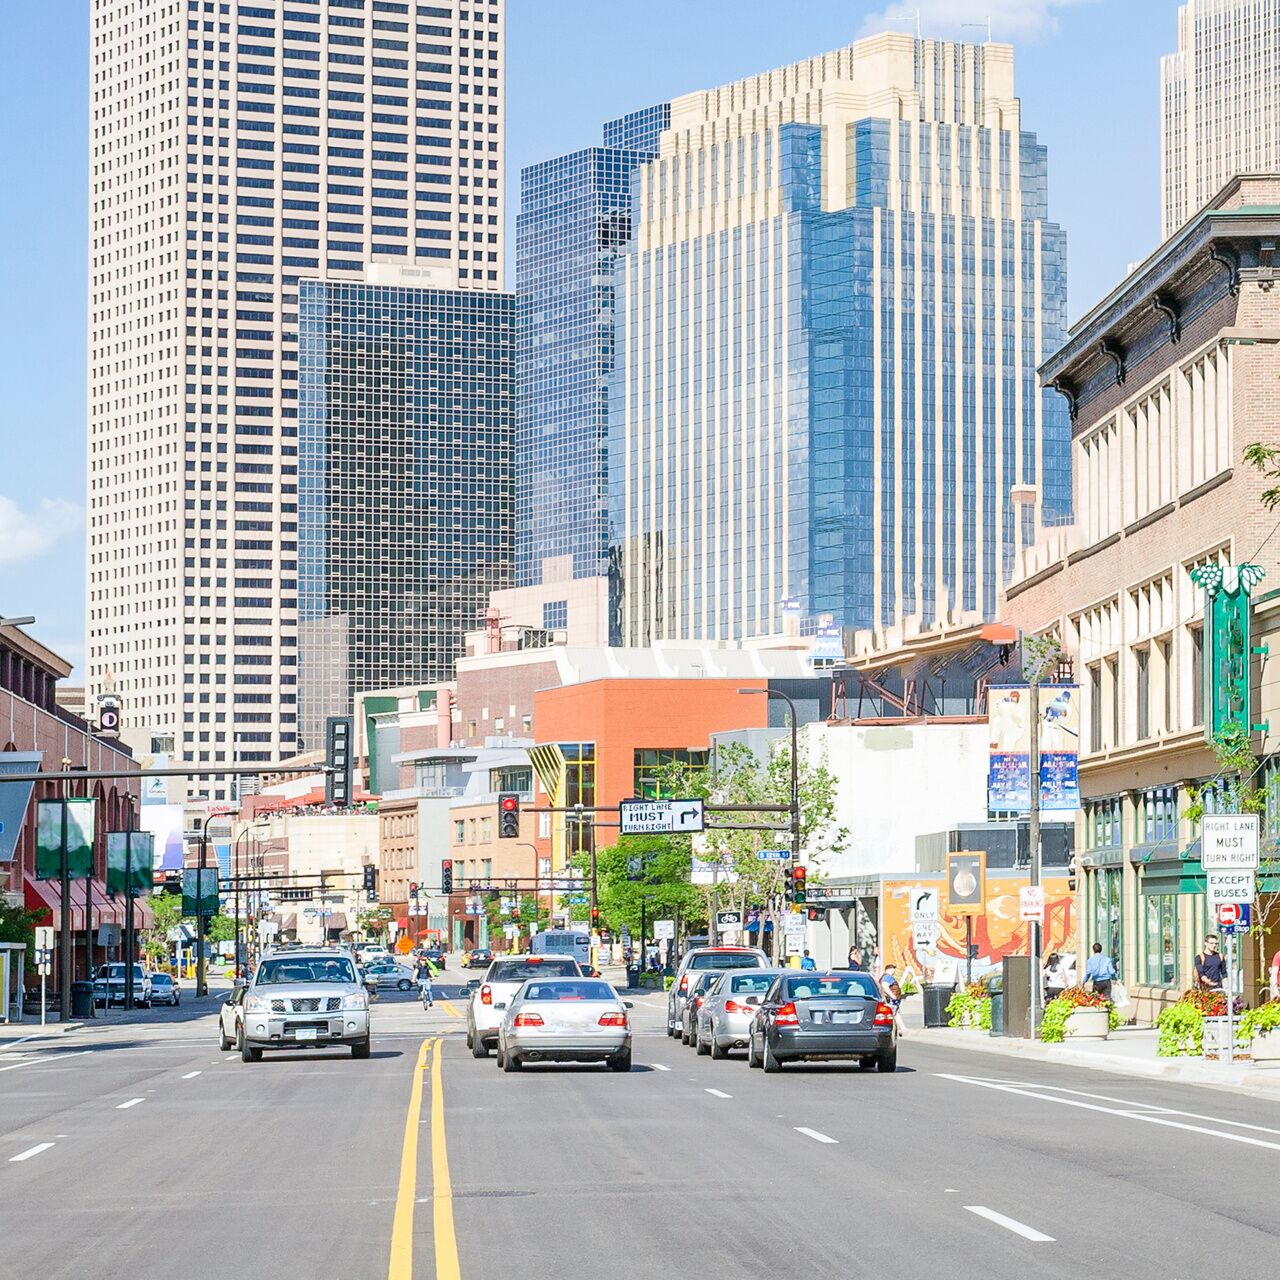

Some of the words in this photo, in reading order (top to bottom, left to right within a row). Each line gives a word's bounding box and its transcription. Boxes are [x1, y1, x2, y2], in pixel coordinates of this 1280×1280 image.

[651, 803, 673, 811] LANE
[629, 812, 664, 821] MUST
[645, 823, 671, 831] RIGHT
[1205, 822, 1230, 831] RIGHT
[1234, 822, 1255, 831] LANE
[1216, 837, 1244, 848] MUST
[1206, 854, 1227, 863] TURN
[1231, 854, 1255, 863] RIGHT
[1210, 876, 1250, 885] EXCEPT
[1213, 889, 1248, 898] BUSES
[916, 931, 933, 939] WAY
